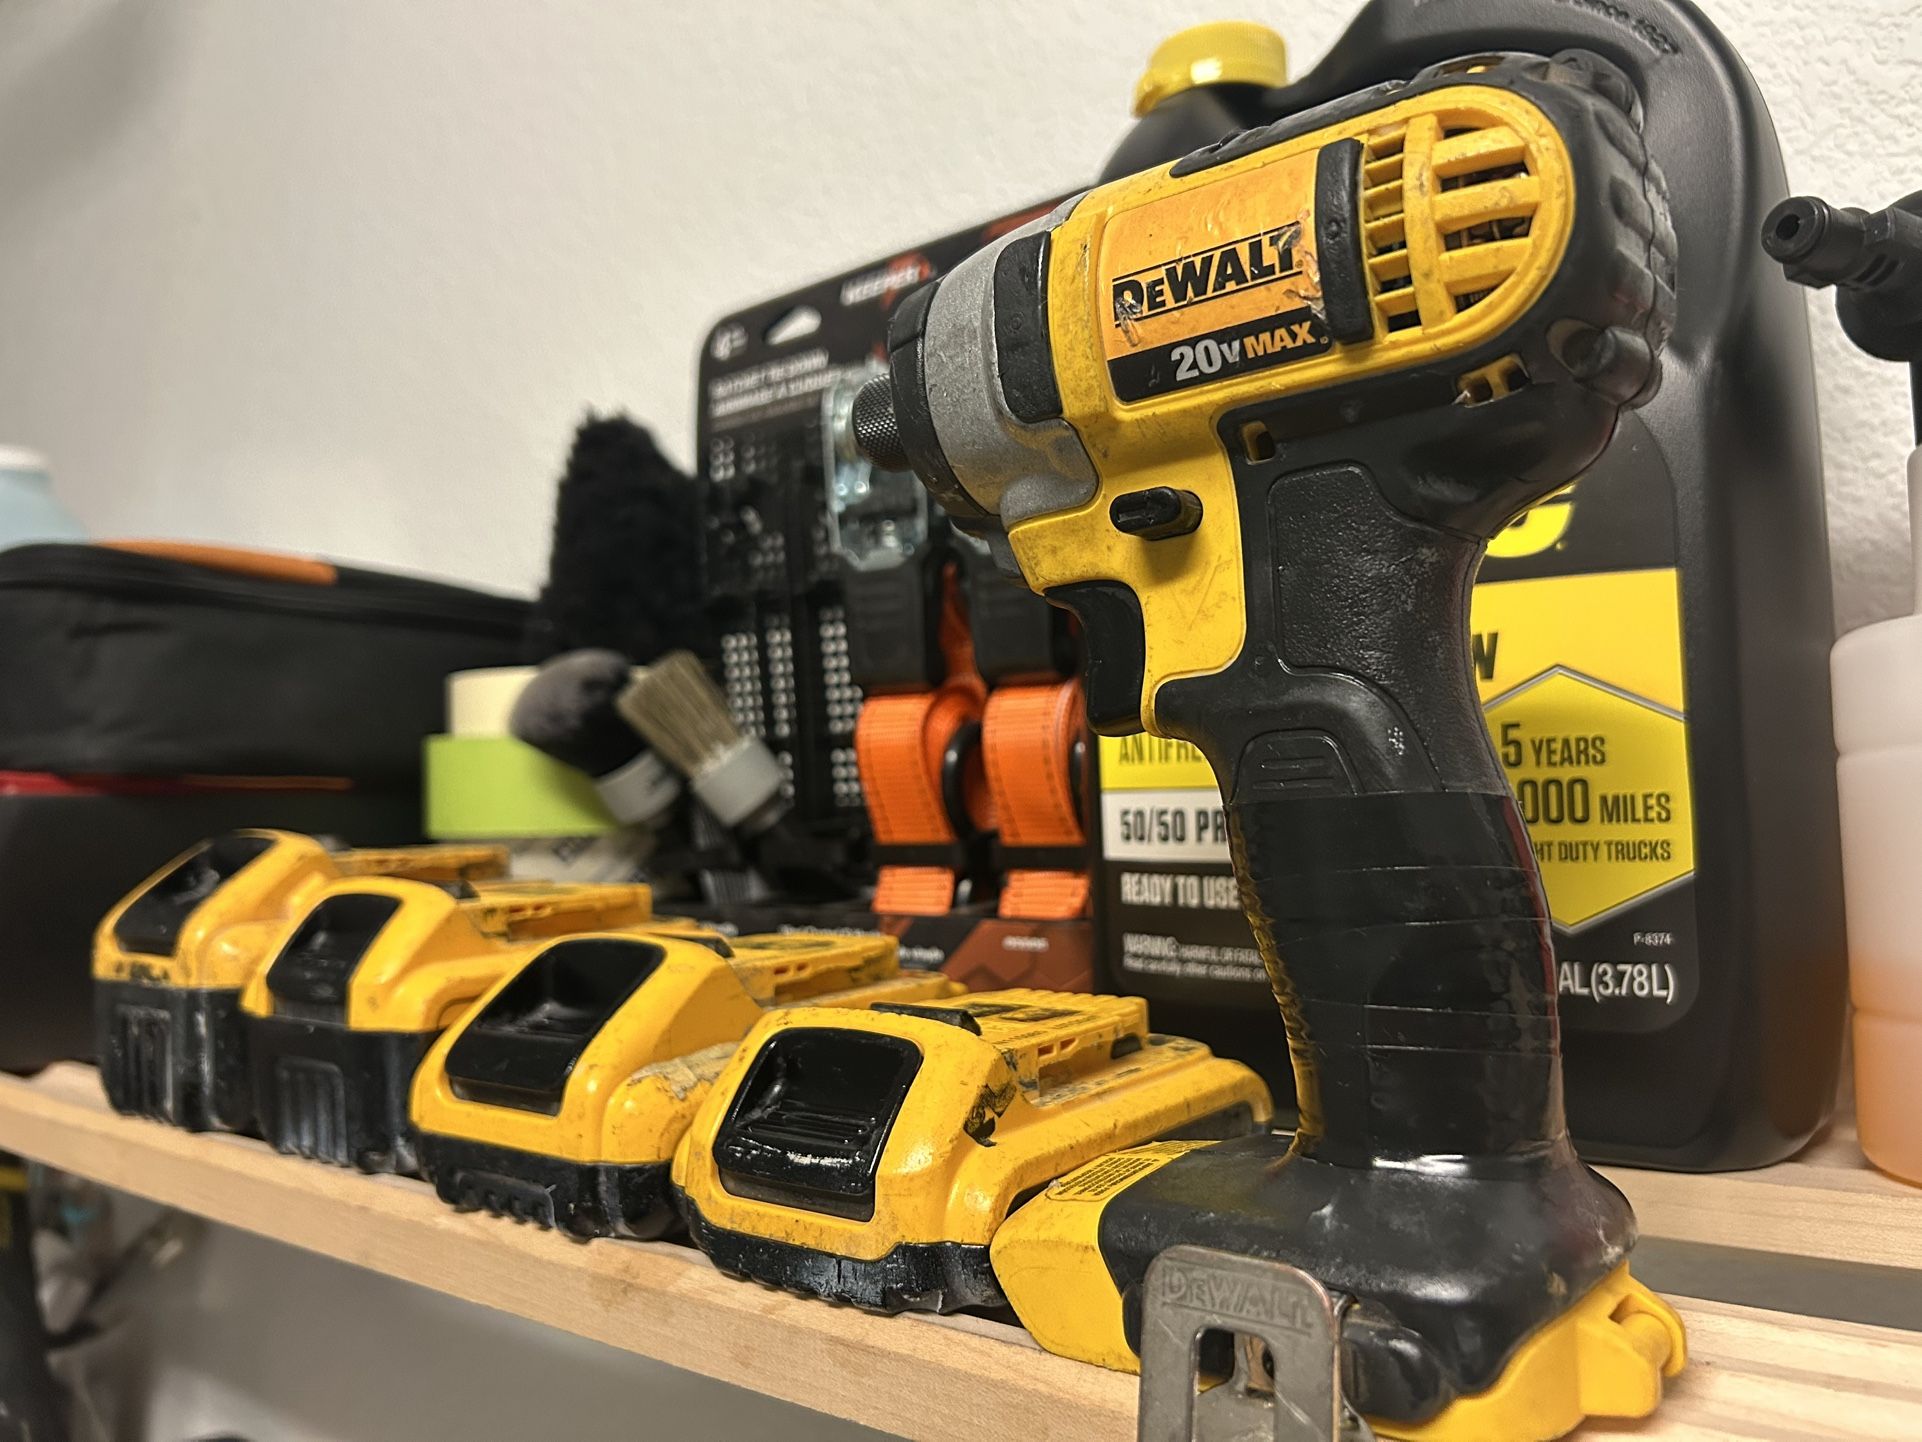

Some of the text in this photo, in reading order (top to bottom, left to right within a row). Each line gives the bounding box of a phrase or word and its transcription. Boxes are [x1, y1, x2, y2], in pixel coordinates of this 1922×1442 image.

[1243, 321, 1316, 359] MAX
[1501, 723, 1607, 768] 5 YEARS
[1120, 808, 1186, 843] 50/50
[1600, 792, 1672, 824] MILES
[1558, 839, 1599, 863] DUTY
[1604, 838, 1672, 863] TRUCKS
[1121, 872, 1239, 910] READY TO USE
